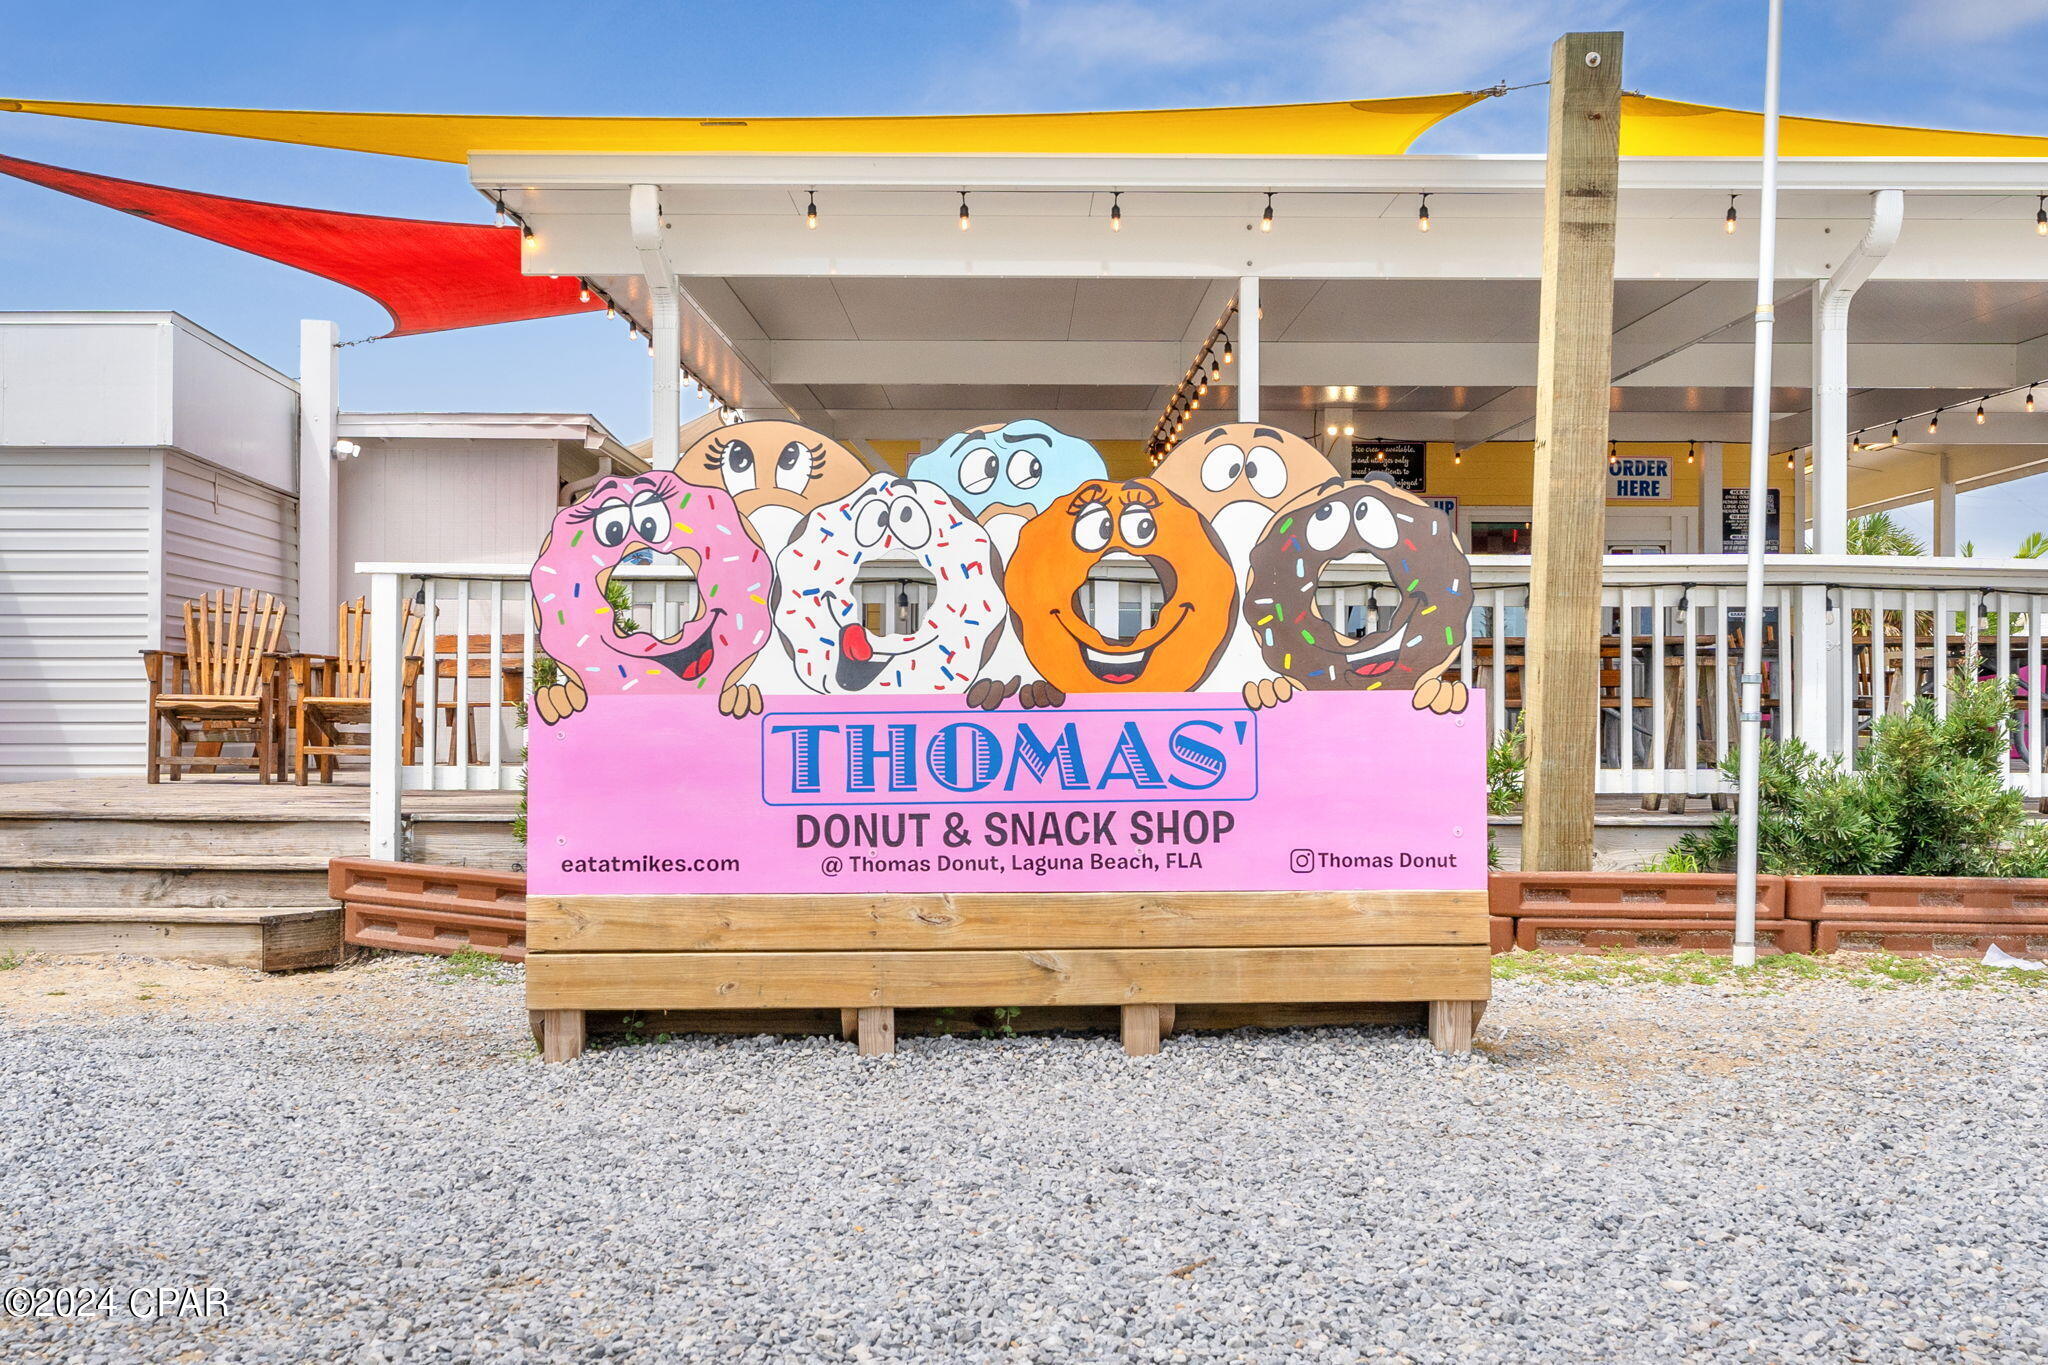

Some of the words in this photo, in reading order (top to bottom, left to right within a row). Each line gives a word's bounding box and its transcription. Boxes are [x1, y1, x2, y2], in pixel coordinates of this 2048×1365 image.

[1609, 459, 1668, 477] ORDER
[1617, 479, 1660, 497] HERE
[770, 720, 1248, 794] THOMAS'
[796, 812, 931, 849] DONUT
[942, 811, 972, 848] &
[984, 809, 1118, 847] SNACK
[1129, 809, 1235, 845] SHOP
[561, 854, 741, 873] eatatmikes.com
[821, 855, 843, 877] @
[849, 855, 931, 873] Thomas
[937, 855, 1005, 873] Donut,
[1011, 854, 1084, 877] Laguna
[1090, 853, 1160, 873] Beach,
[1166, 852, 1203, 869] FLA
[1317, 852, 1394, 868] Thomas
[1400, 852, 1457, 868] Donut
